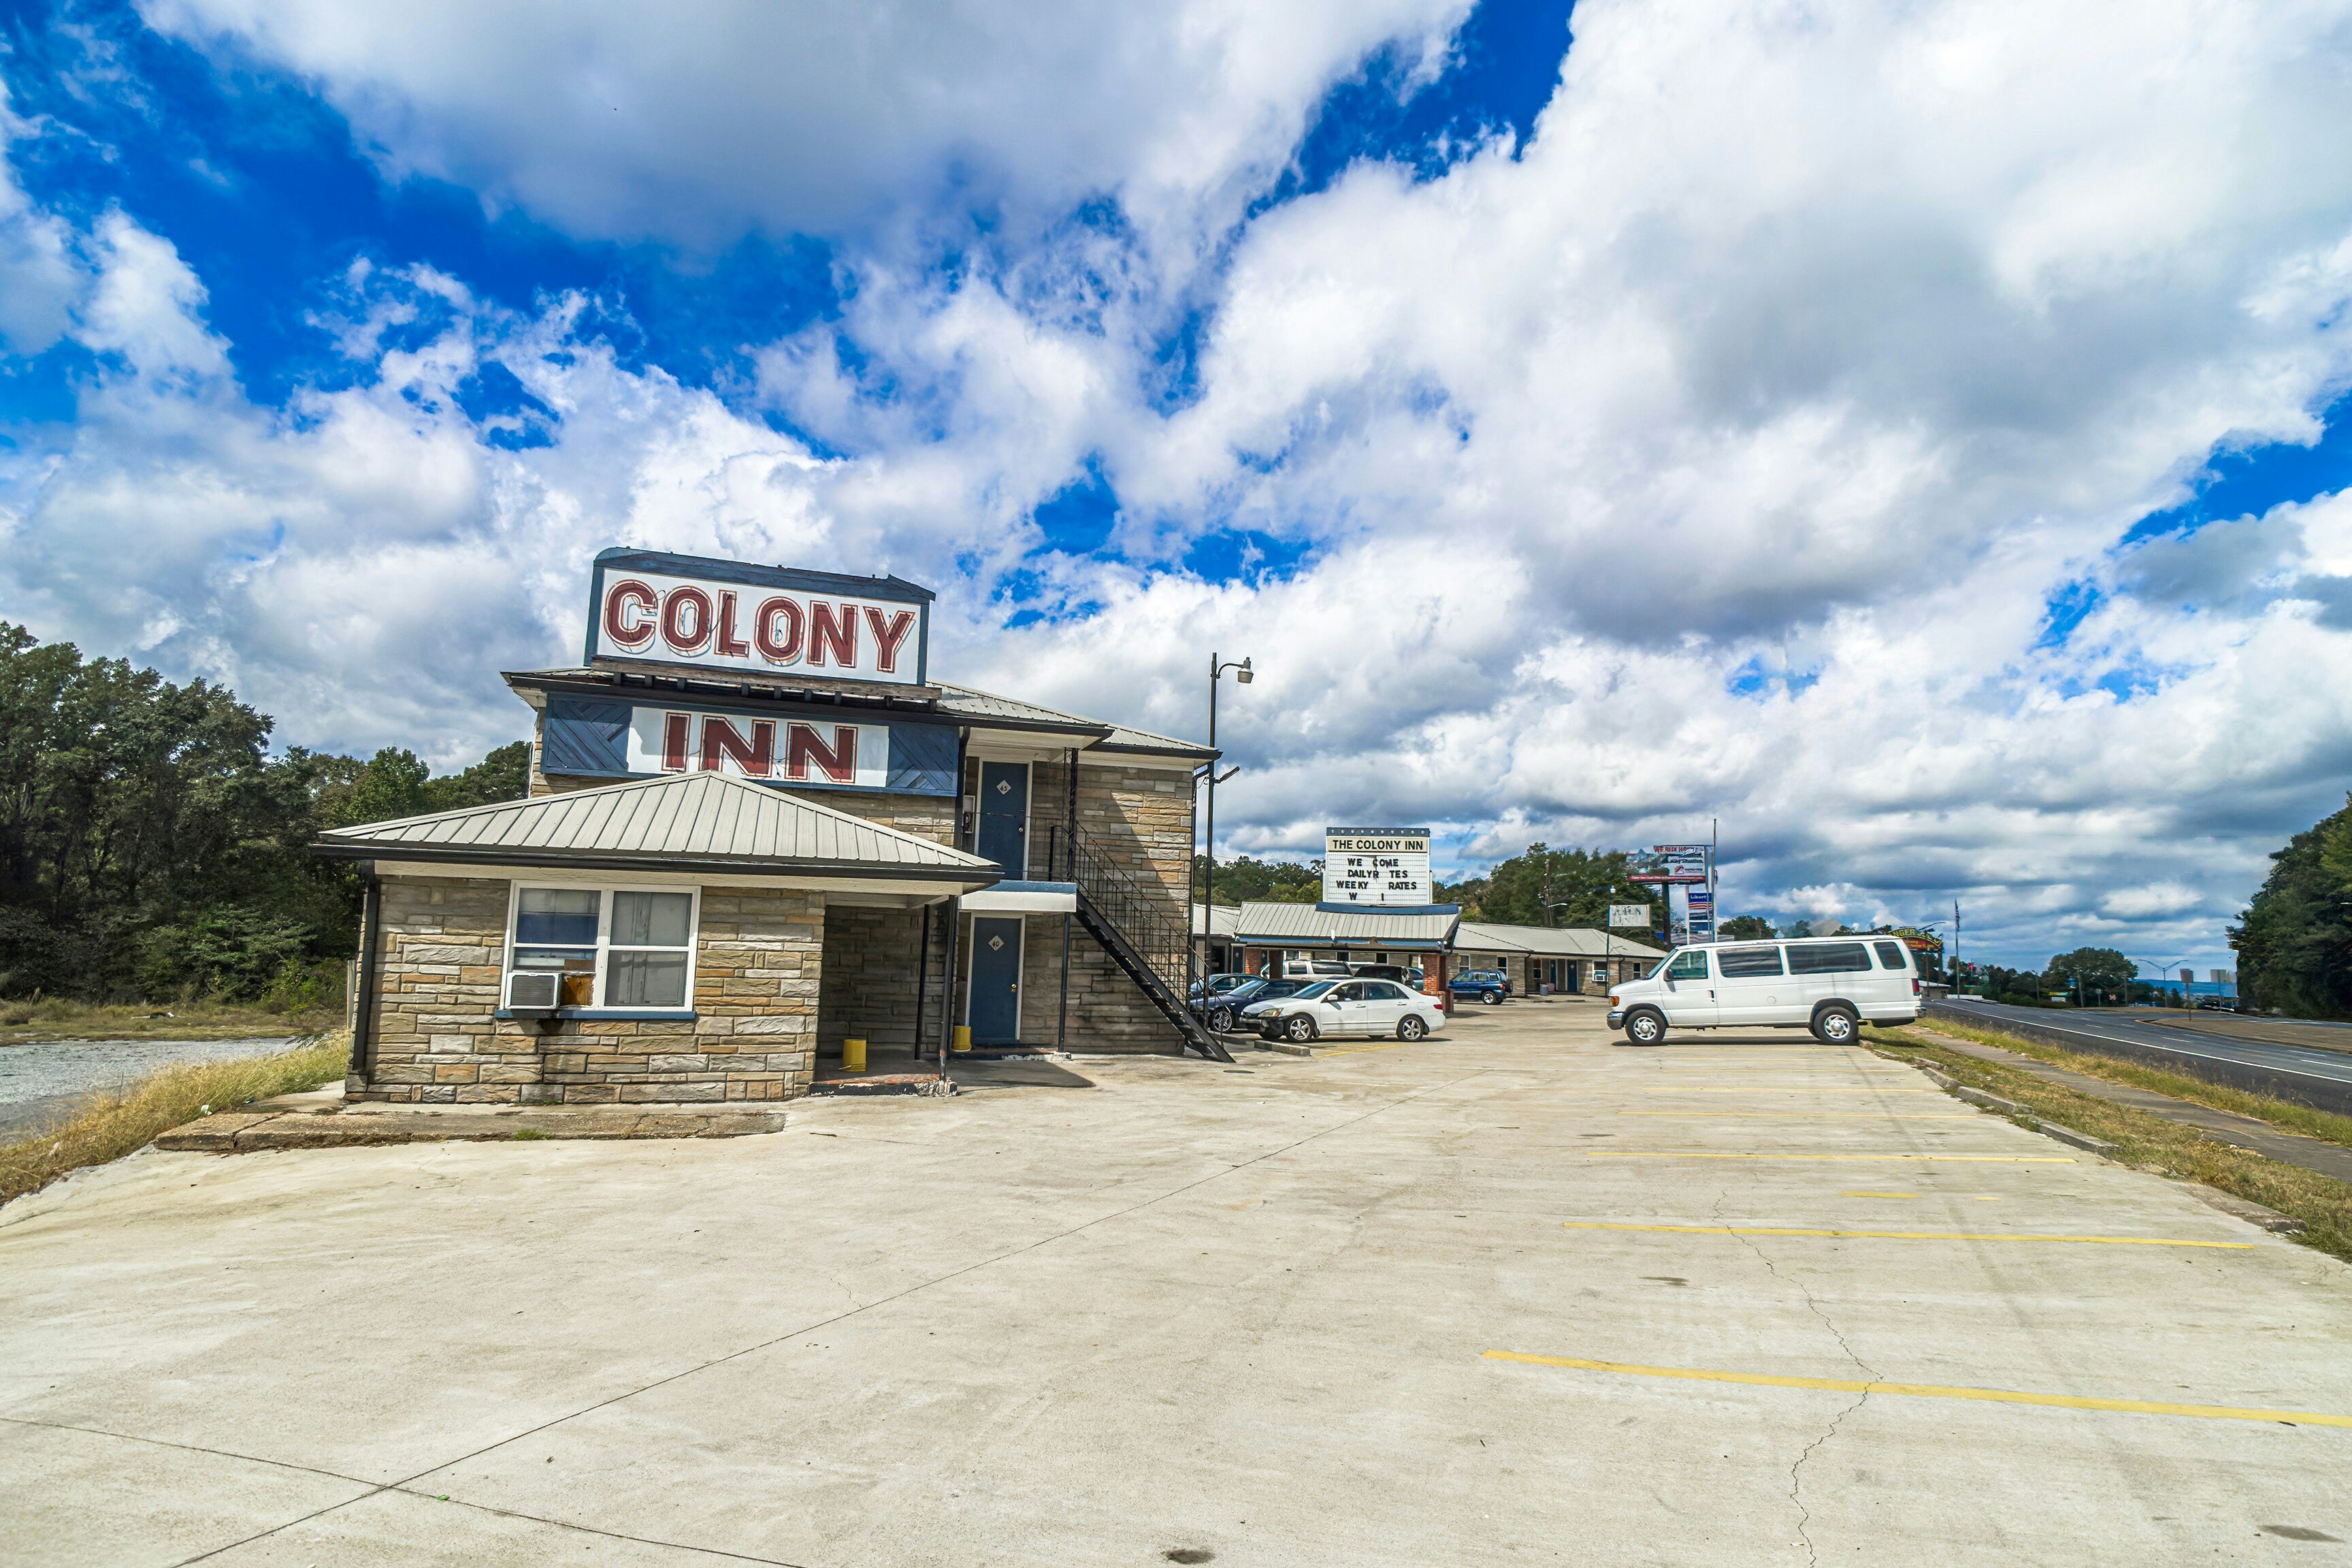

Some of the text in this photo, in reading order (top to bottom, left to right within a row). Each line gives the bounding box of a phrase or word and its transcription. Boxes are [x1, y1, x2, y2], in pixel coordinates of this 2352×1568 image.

[603, 579, 916, 673] COLONY
[661, 712, 859, 783] INN
[1333, 840, 1423, 851] THE COLONY INN
[1388, 881, 1417, 889] RATES
